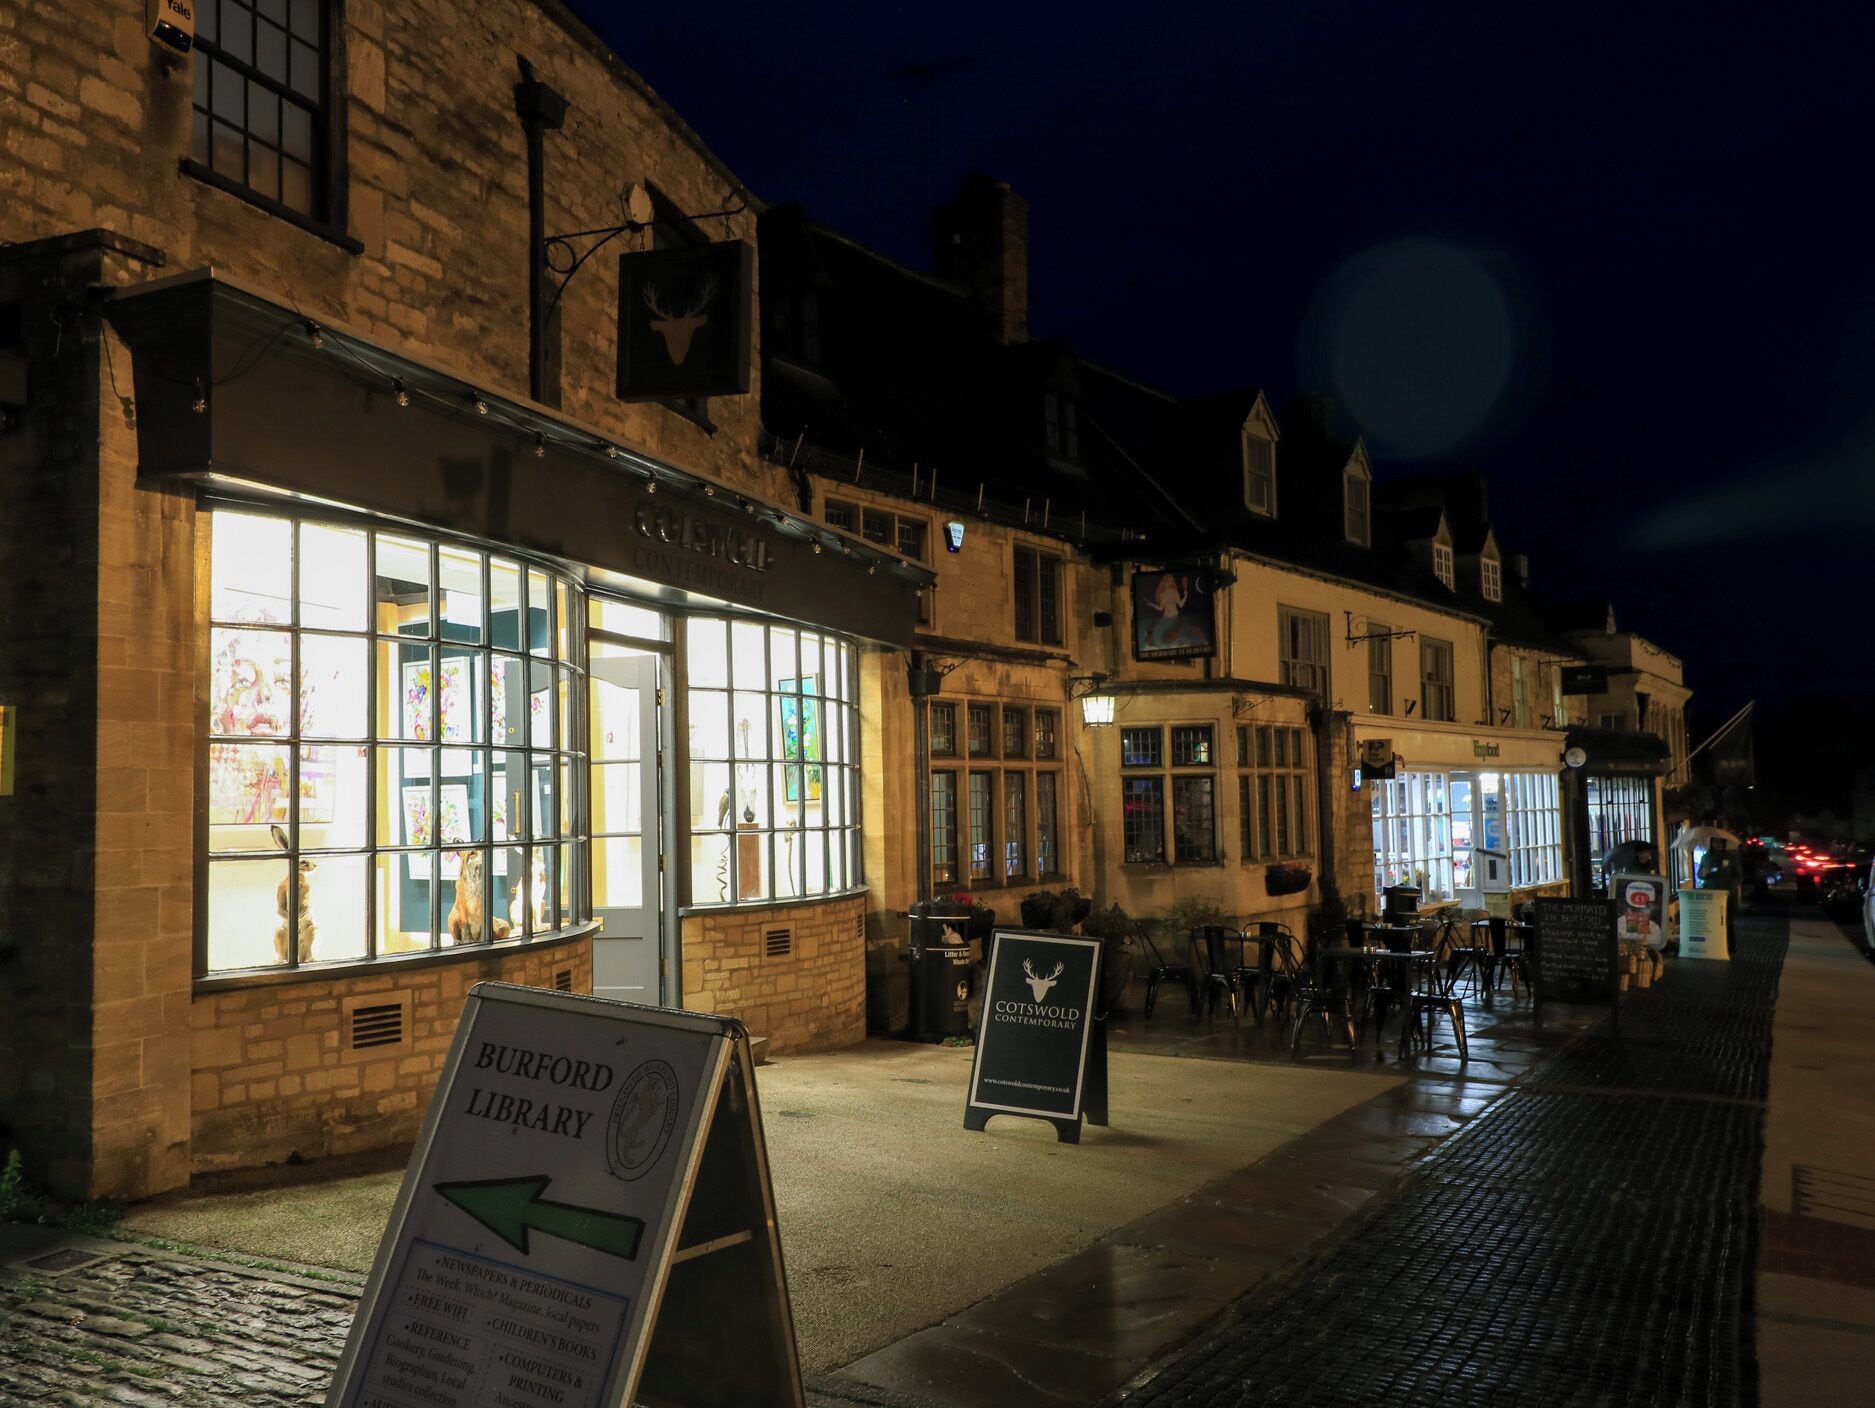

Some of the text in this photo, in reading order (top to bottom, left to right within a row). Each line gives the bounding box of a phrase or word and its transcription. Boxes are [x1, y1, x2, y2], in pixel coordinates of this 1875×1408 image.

[994, 1013, 1077, 1030] CONTEMPORARY
[995, 1000, 1079, 1021] COTSWOLD
[474, 1042, 614, 1091] BURFORD
[464, 1088, 594, 1139] LIBRARY
[440, 1256, 592, 1309] NEWSPAPERS & PERIODICALS
[414, 1295, 468, 1319] FREE WIFI
[416, 1268, 434, 1283] The
[545, 1306, 567, 1322] local
[568, 1315, 600, 1333] papers
[410, 1322, 471, 1351] REFERENCE
[492, 1318, 597, 1361] CHILDREN'S BOOKS
[440, 1371, 467, 1390] Local
[503, 1353, 583, 1389] COMPUTERS &
[382, 1374, 456, 1407] studies collection
[508, 1374, 565, 1404] PRINTING
